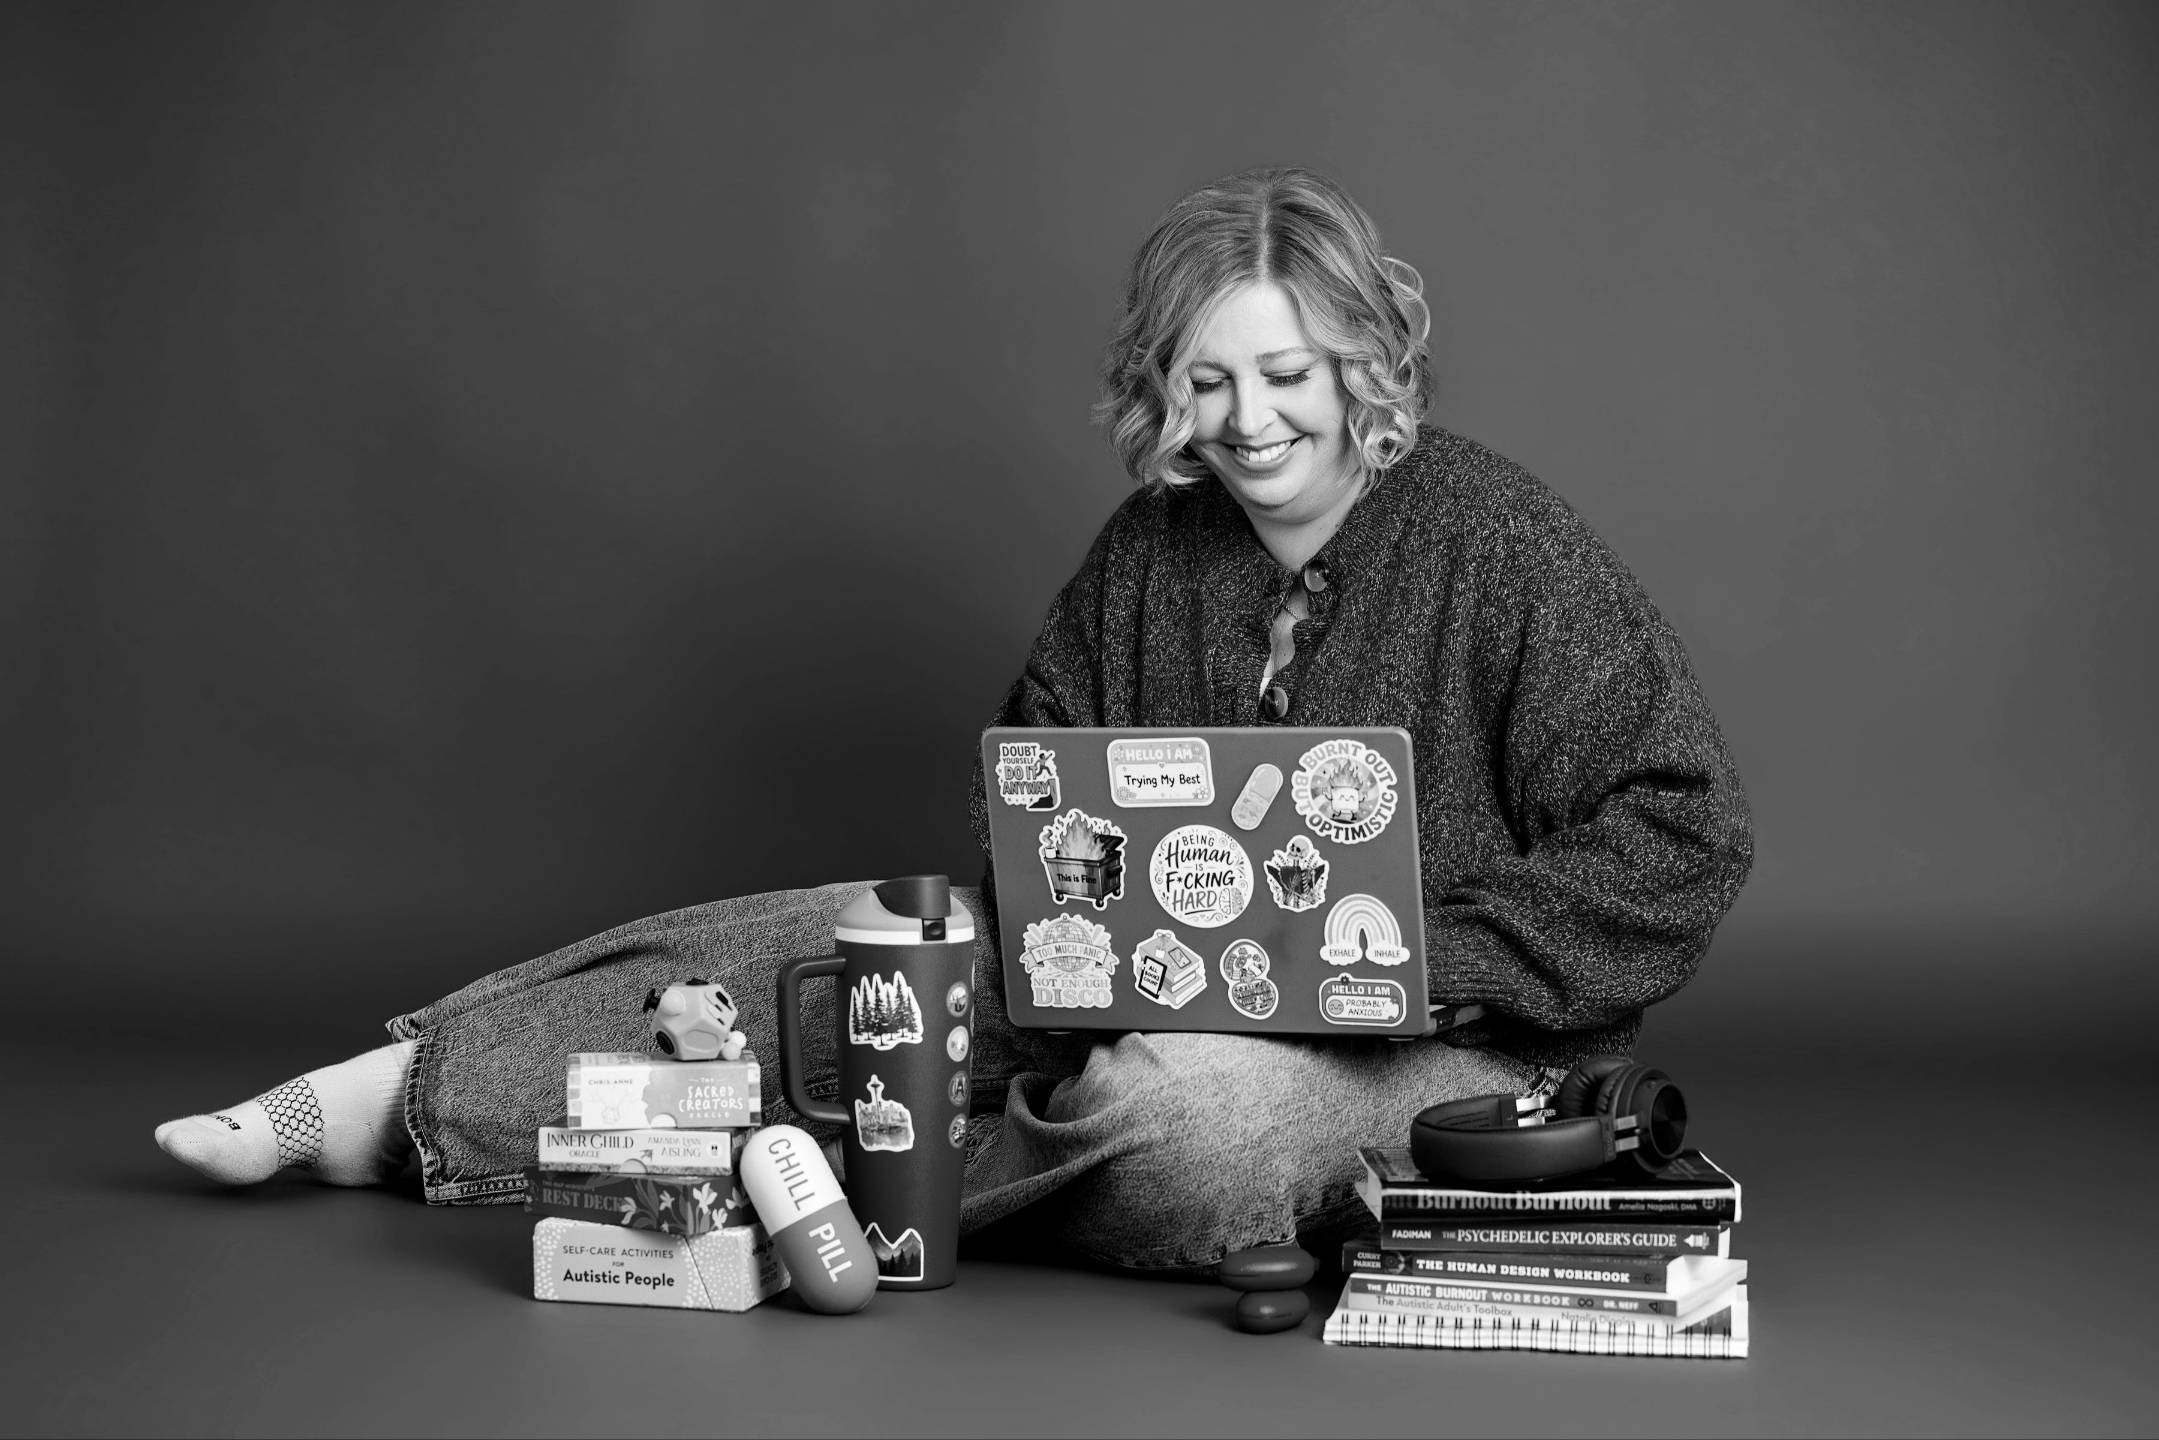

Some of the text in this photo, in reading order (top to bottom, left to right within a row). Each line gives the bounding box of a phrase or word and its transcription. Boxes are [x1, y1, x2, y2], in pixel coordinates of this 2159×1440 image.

[1002, 745, 1037, 757] DOUBT
[1125, 748, 1163, 761] HELLO
[1174, 747, 1193, 760] AM
[1303, 743, 1394, 782] BURNT OUT
[1004, 766, 1038, 780] DO IT
[1002, 781, 1050, 795] ANYWAY
[1124, 774, 1201, 788] Trying My Best
[1295, 775, 1314, 811] BUT
[1309, 792, 1394, 840] OPTIMISTIC
[1182, 834, 1215, 847] BEING
[1165, 840, 1234, 869] Human
[1057, 873, 1071, 882] This
[1073, 874, 1080, 882] is
[1172, 889, 1217, 912] HARD
[1036, 945, 1102, 959] TOO MUCH PANIC
[1329, 949, 1356, 957] EXHALE
[1374, 950, 1400, 958] INHALE
[1034, 978, 1108, 988] NOT ENOUGH
[1331, 985, 1391, 995] HELLO I AM
[1034, 988, 1112, 1006] DISCO
[1346, 999, 1386, 1008] PROBABLY
[1348, 1008, 1382, 1017] ANXIOUS
[547, 1133, 634, 1149] INNER CHILD
[569, 1150, 599, 1158] ORACLE
[768, 1138, 816, 1211] CHILL
[542, 1188, 581, 1208] REST
[1417, 1190, 1512, 1209] Burnout
[1515, 1190, 1611, 1210] Burnout
[1392, 1229, 1677, 1247] FADIMAN THE PSYCHEDELIC EXPLORER'S GUIDE
[621, 1248, 674, 1259] ACTIVITIES
[808, 1222, 853, 1283] PILL
[1357, 1252, 1381, 1260] CURRY
[1353, 1260, 1381, 1269] PARKER
[1416, 1259, 1630, 1283] THE HUMAN DESIGN WORKBOOK
[563, 1268, 675, 1290] Autistic People
[1367, 1283, 1382, 1291] THE
[1386, 1283, 1432, 1297] AUTISTIC
[1436, 1285, 1488, 1301] BURNOUT
[1491, 1291, 1571, 1306] WORKBOOK
[1619, 1301, 1639, 1310] NEFF
[1376, 1295, 1395, 1306] The
[1397, 1298, 1434, 1310] Autistic
[1436, 1301, 1471, 1313] Adult's
[1473, 1304, 1513, 1317] Toolbox
